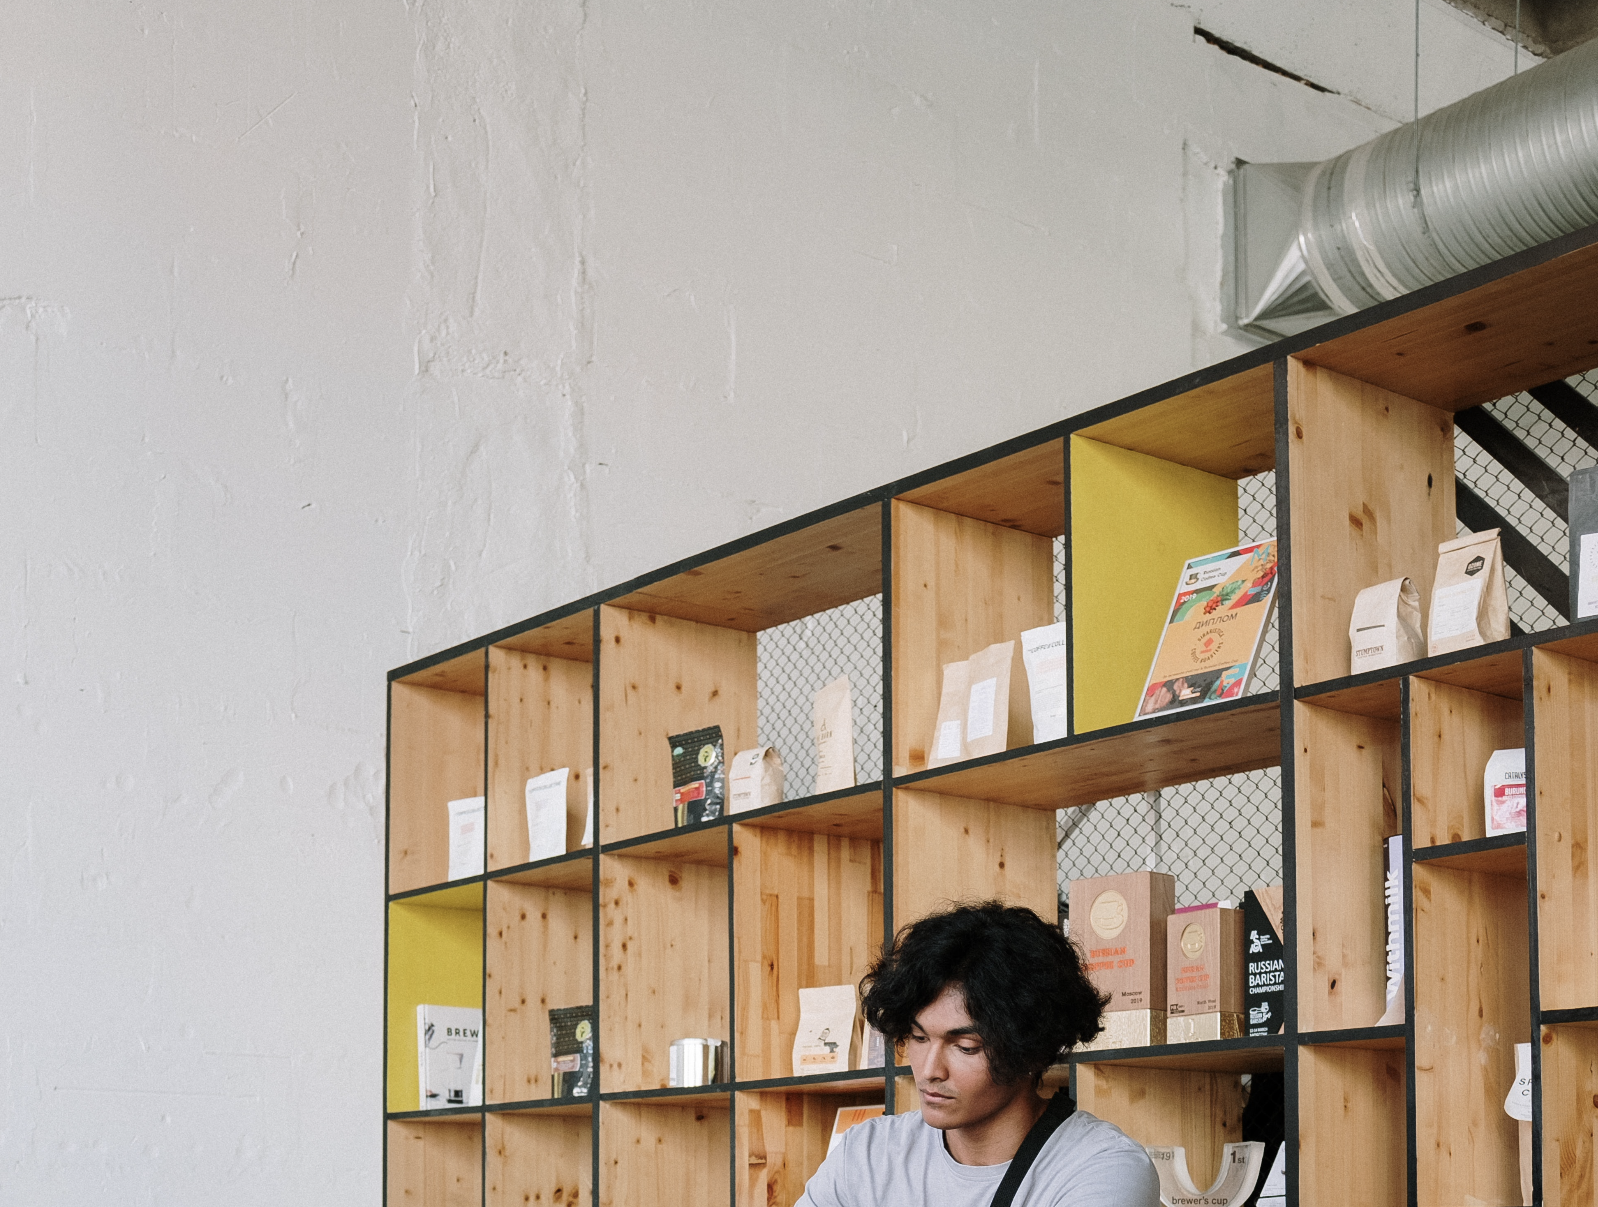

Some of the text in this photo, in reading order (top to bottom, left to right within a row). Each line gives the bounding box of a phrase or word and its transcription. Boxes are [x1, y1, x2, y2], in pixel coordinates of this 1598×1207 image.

[1180, 593, 1197, 603] 2019
[1193, 612, 1239, 631] ДИПЛОМ
[1355, 644, 1385, 657] STUMPTOWN
[1116, 958, 1135, 969] CUP
[1249, 958, 1284, 974] RUSSIAN
[1249, 971, 1284, 987] BARISTA
[446, 1027, 480, 1038] BREW
[1230, 1150, 1246, 1164] 1st
[1171, 1196, 1229, 1207] brewer's cup
